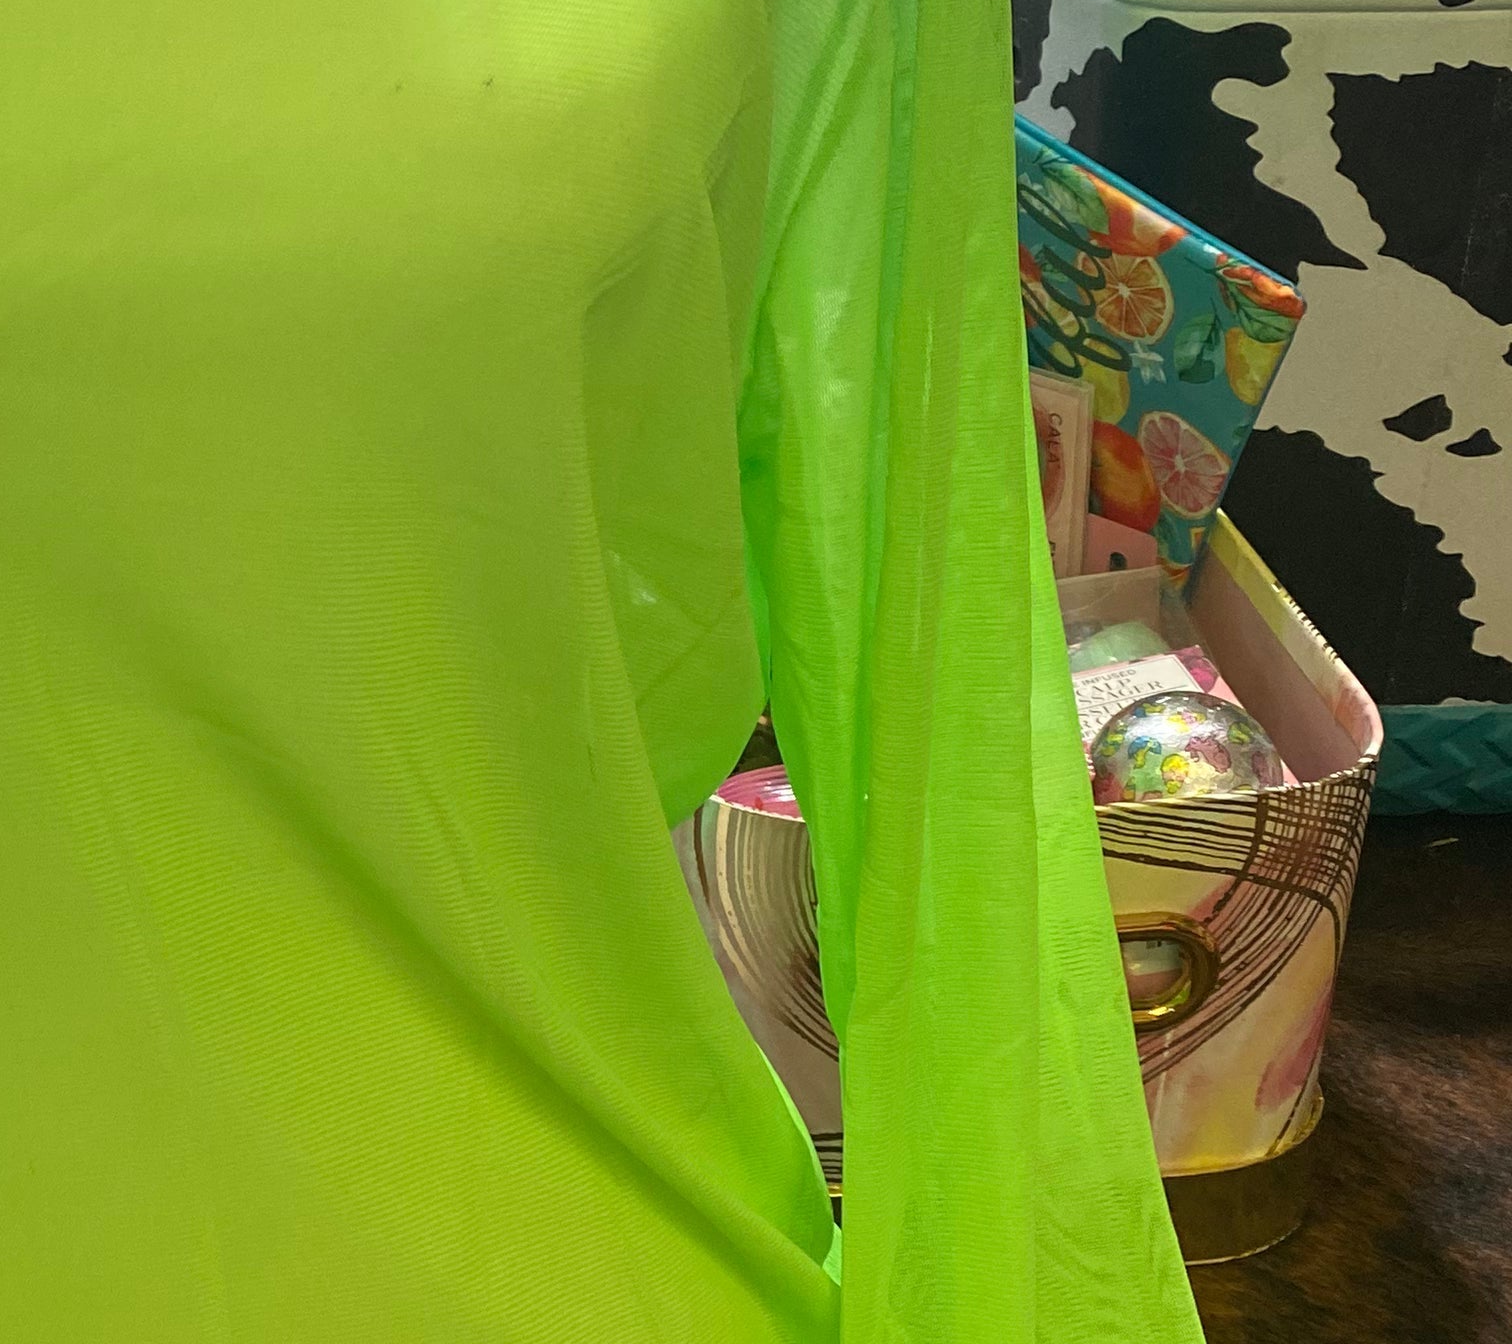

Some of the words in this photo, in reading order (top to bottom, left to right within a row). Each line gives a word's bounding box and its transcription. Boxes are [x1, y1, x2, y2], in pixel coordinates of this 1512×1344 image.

[1047, 412, 1063, 463] CALA
[1075, 678, 1131, 697] CALP
[1081, 669, 1137, 686] INFUSED
[1078, 681, 1165, 704] SSAGER
